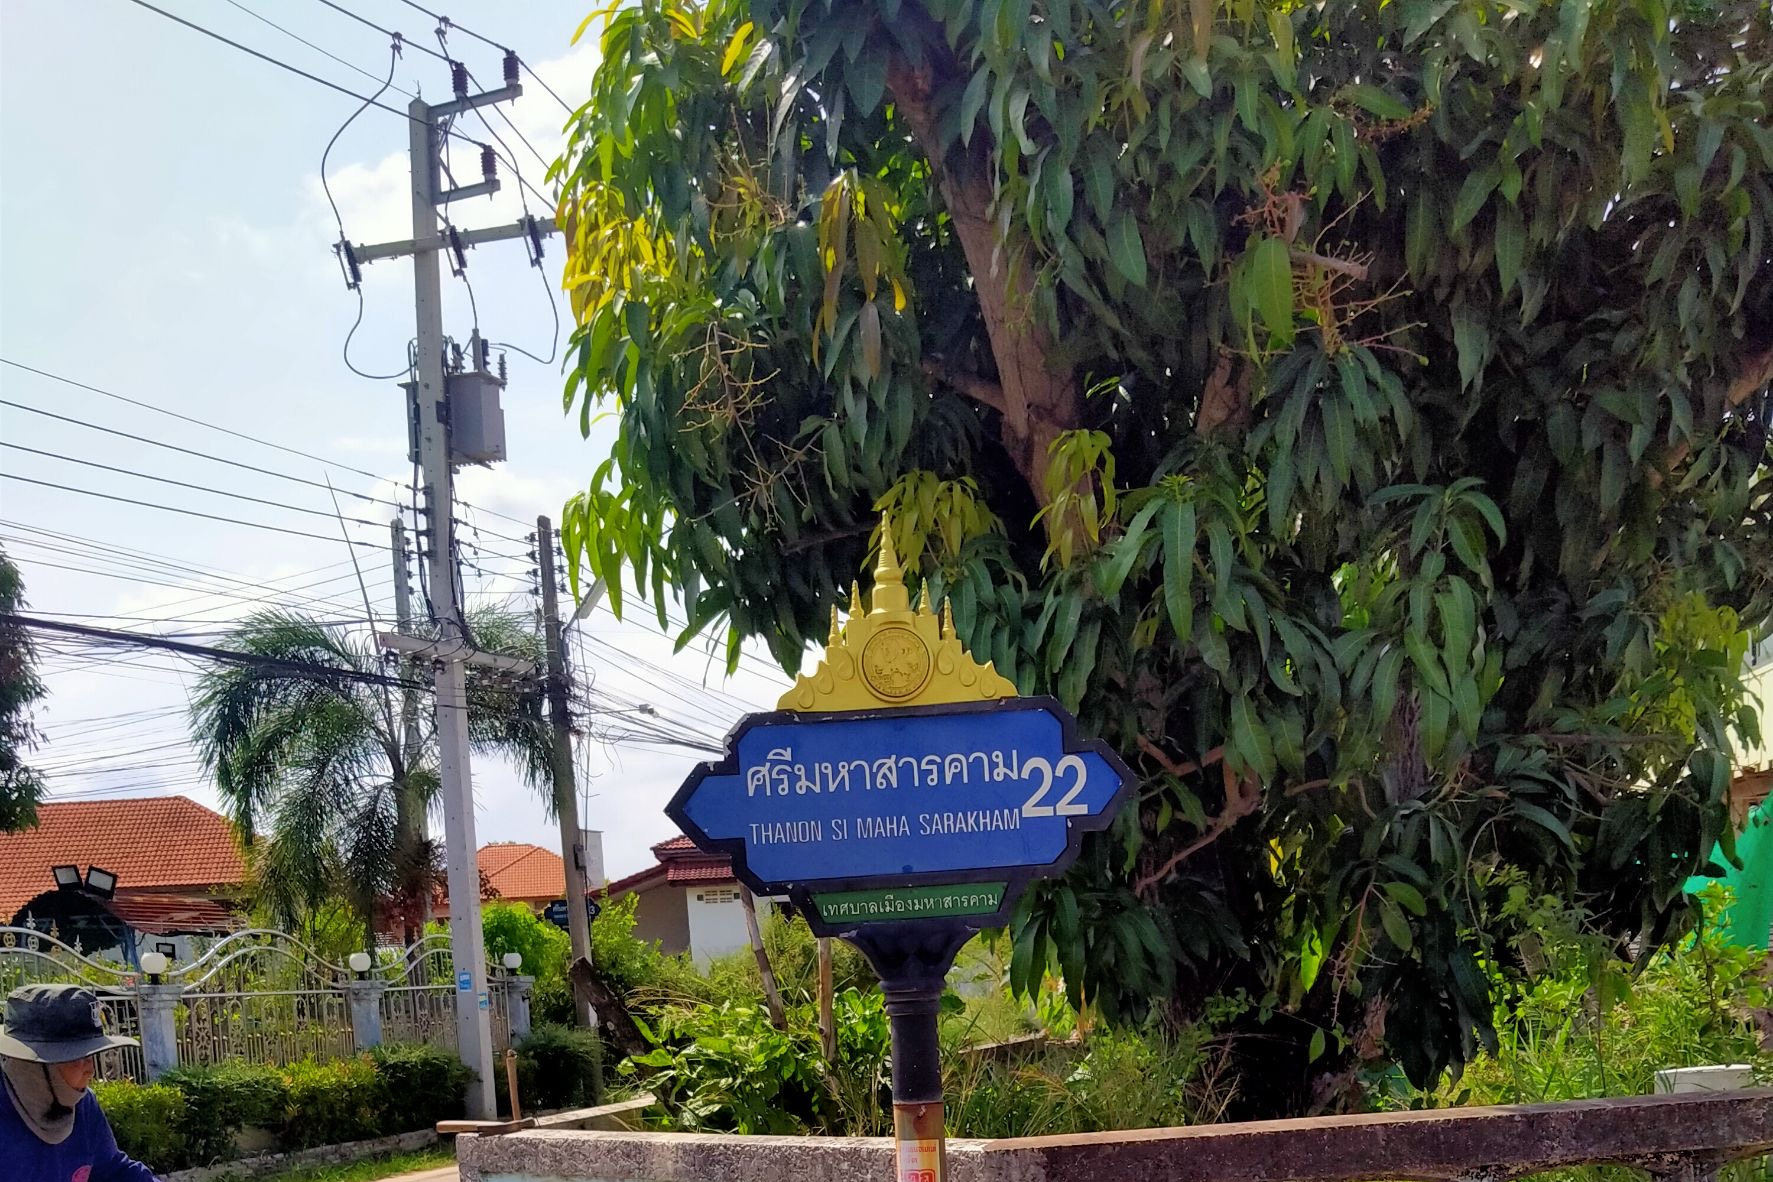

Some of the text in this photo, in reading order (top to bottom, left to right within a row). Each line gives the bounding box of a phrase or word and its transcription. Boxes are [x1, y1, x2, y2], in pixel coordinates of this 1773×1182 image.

[747, 747, 1089, 818] ศรีมหาสารคาม 22
[749, 807, 1021, 846] THANON SI MAHA SARAKHAM
[822, 893, 998, 917] เทศบาลเมืองมหาสารคาม
